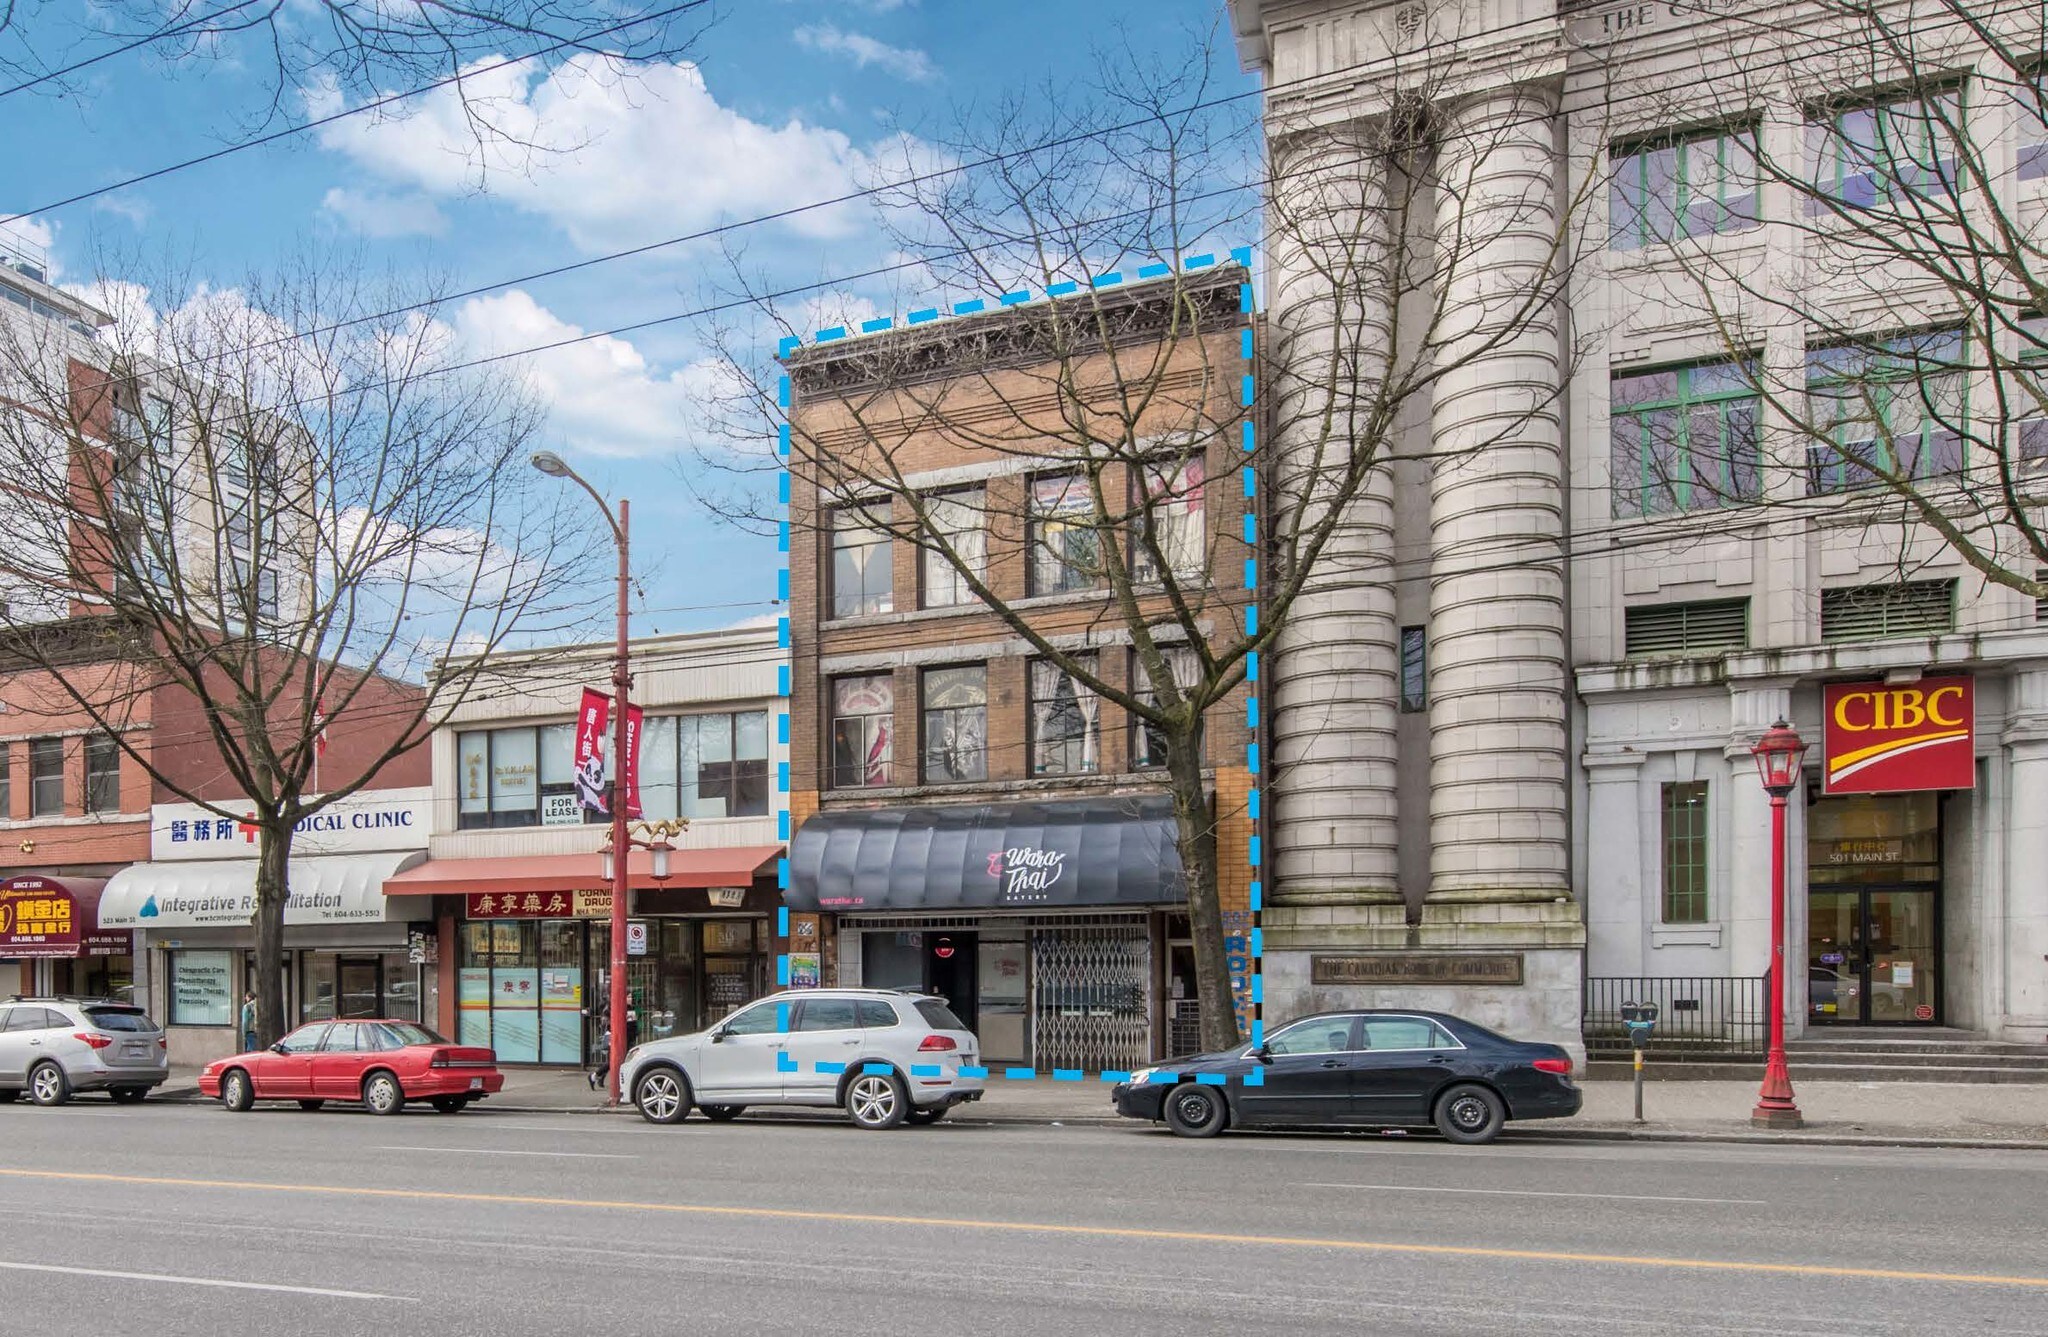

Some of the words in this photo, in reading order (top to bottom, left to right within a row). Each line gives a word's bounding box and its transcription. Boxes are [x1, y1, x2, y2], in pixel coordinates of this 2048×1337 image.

[1602, 4, 1654, 33] THE
[1834, 686, 1964, 731] CIBC
[582, 707, 597, 757] 唐人街
[545, 807, 578, 817] LEASE
[551, 798, 572, 807] FOR
[171, 818, 233, 843] 醫務所
[292, 815, 345, 832] DICAL
[352, 810, 413, 829] CLINIC
[1006, 847, 1066, 868] Wara
[1829, 853, 1848, 862] 501
[1852, 852, 1882, 862] MAIN
[1885, 851, 1899, 861] ST
[1006, 864, 1062, 893] Thai
[578, 888, 613, 898] CORNI
[161, 895, 235, 915] Integrative
